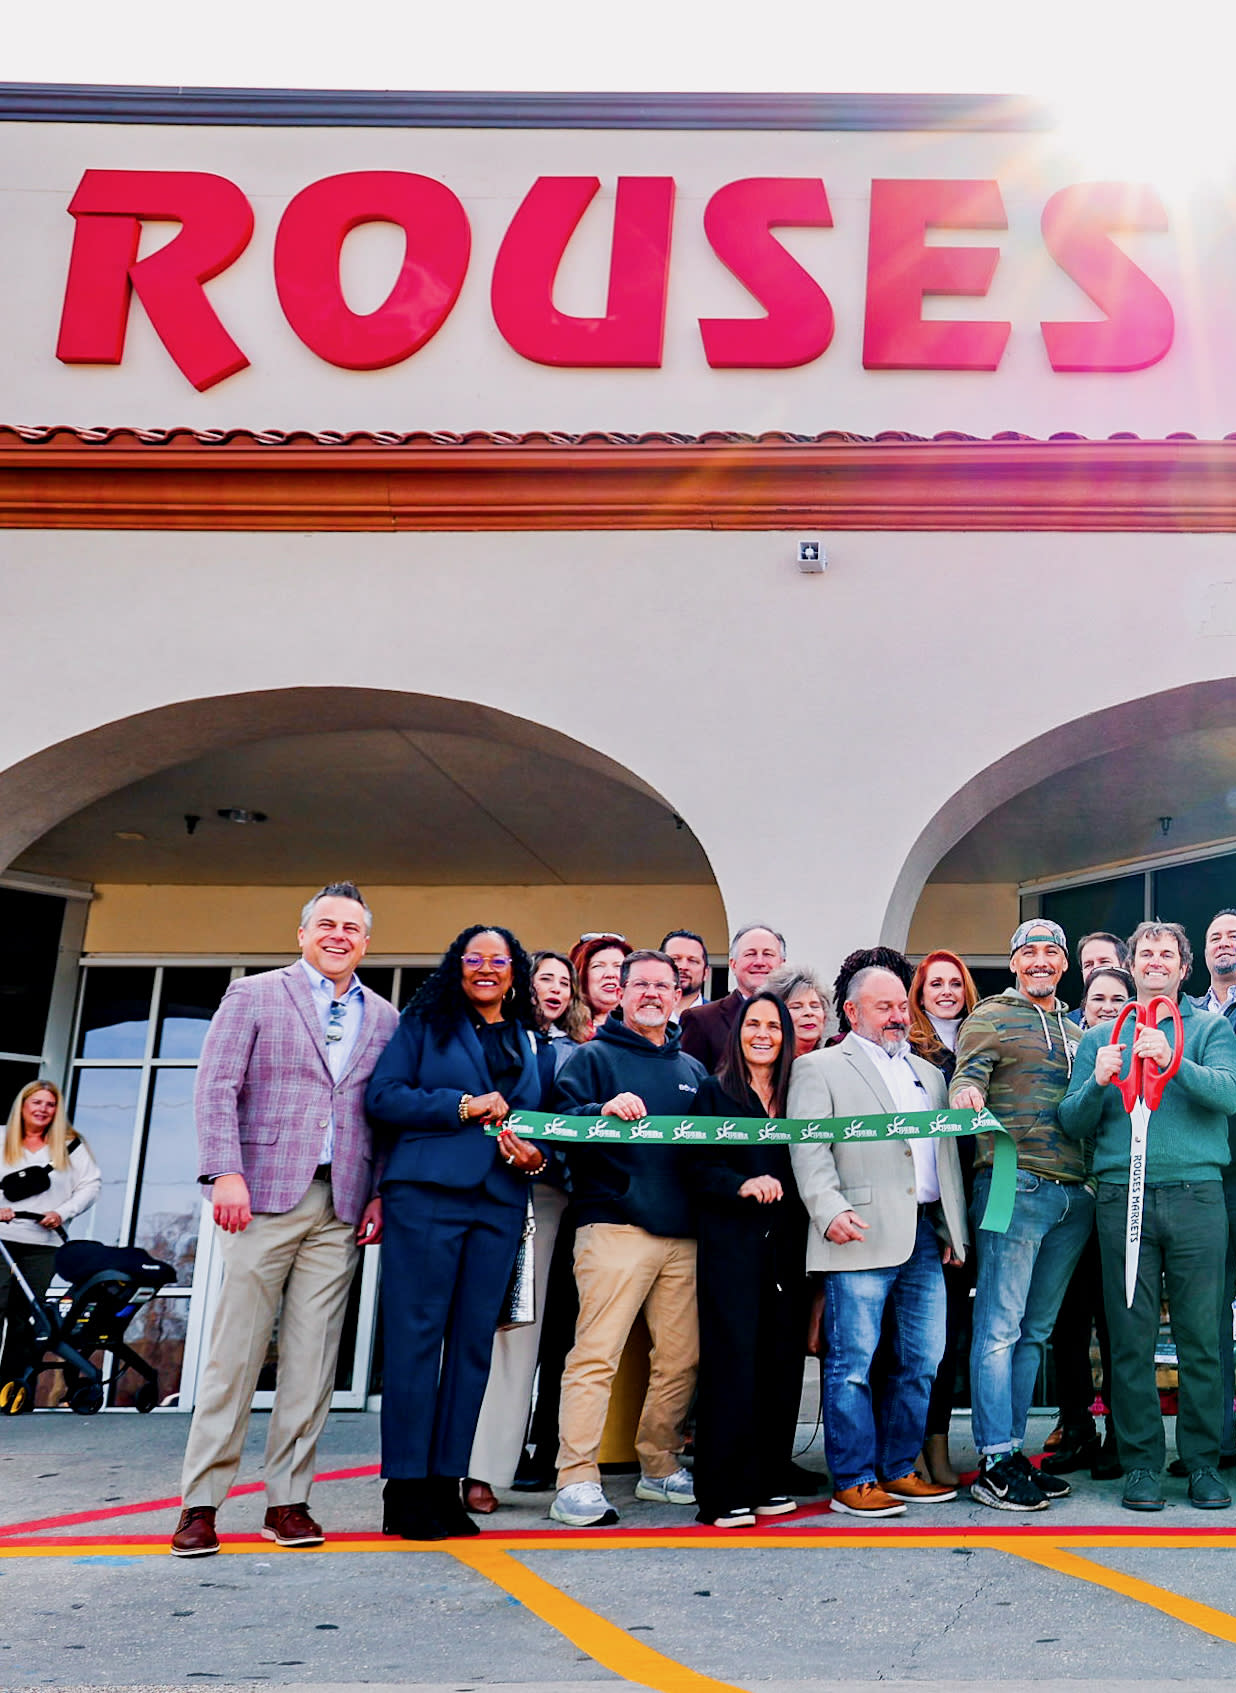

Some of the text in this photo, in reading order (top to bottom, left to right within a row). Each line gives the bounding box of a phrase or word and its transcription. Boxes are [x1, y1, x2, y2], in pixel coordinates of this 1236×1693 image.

[55, 168, 1176, 393] ROUSES
[1130, 1154, 1142, 1243] ROUSES MARKETS
